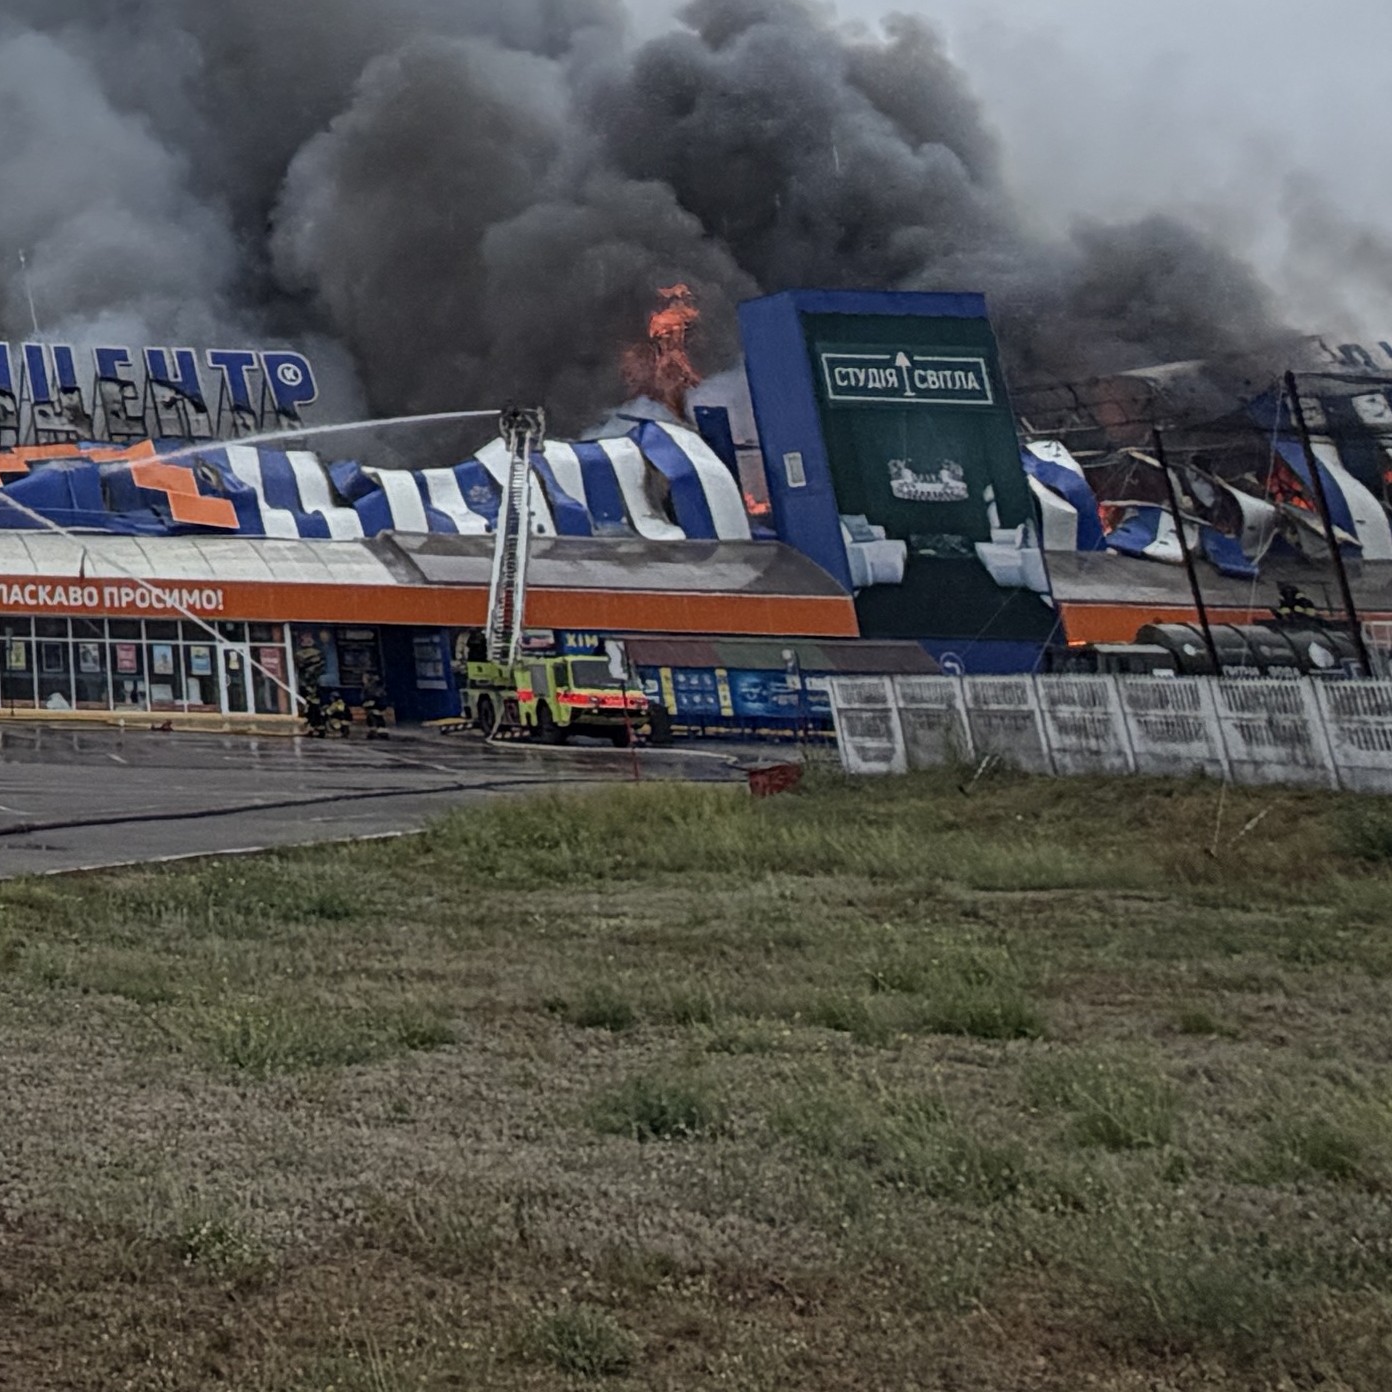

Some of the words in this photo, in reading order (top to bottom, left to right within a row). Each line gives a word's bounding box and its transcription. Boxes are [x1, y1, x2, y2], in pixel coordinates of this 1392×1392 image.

[833, 367, 899, 389] СТУДІЯ
[913, 369, 981, 390] СВІТЛА
[103, 586, 225, 611] ПРОСИМО!
